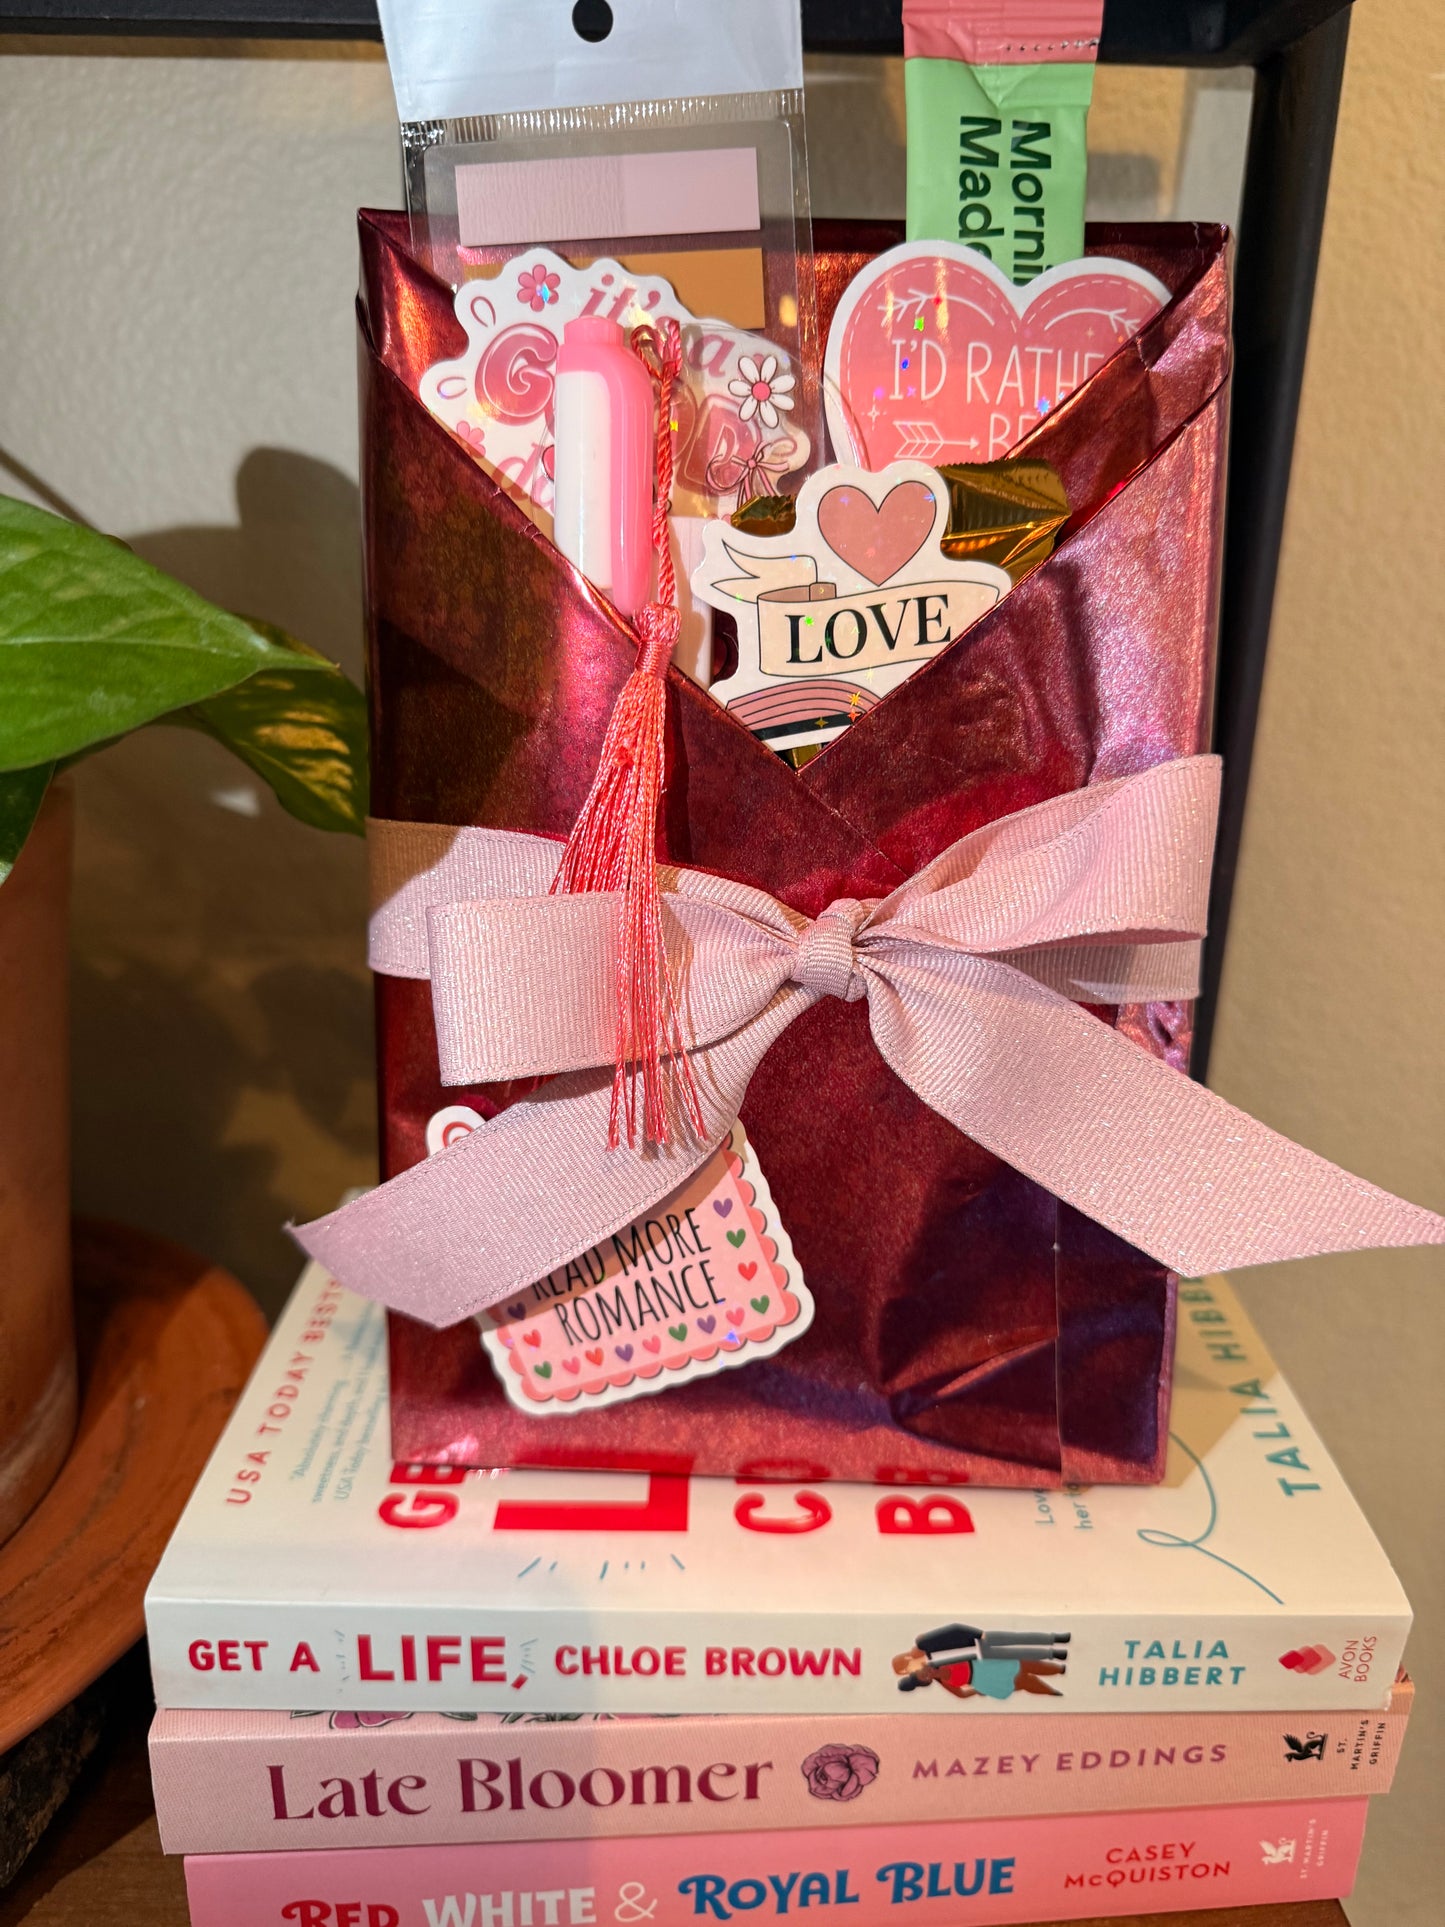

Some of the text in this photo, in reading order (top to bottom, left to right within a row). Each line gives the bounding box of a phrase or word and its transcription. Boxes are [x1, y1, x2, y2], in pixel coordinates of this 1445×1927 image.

[889, 338, 946, 401] I'D
[784, 593, 952, 664] LOVE
[611, 1208, 711, 1276] MORE
[554, 1259, 726, 1346] ROMANCE
[226, 1450, 271, 1505] USA
[257, 1351, 314, 1436] TODAY
[1228, 1377, 1322, 1497] TALIA
[188, 1634, 862, 1690] GET A LIFE, CHLOE BROWN
[1124, 1640, 1230, 1660] TALIA
[1338, 1640, 1359, 1679] AVON
[1354, 1635, 1377, 1682] BOOKS
[1098, 1666, 1247, 1687] HIBBERT
[912, 1744, 1228, 1780] MAZEY EDDINGS
[1351, 1719, 1369, 1770] MARTIN'S
[1369, 1722, 1386, 1765] GRIFFIN
[266, 1756, 774, 1821] Late Bloomer
[1105, 1841, 1197, 1865] CASEY
[1316, 1829, 1328, 1867] GRIFFIN
[281, 1857, 1017, 1927] RED WHITE & ROYAL BLUE
[1063, 1860, 1232, 1890] McQUISTON
